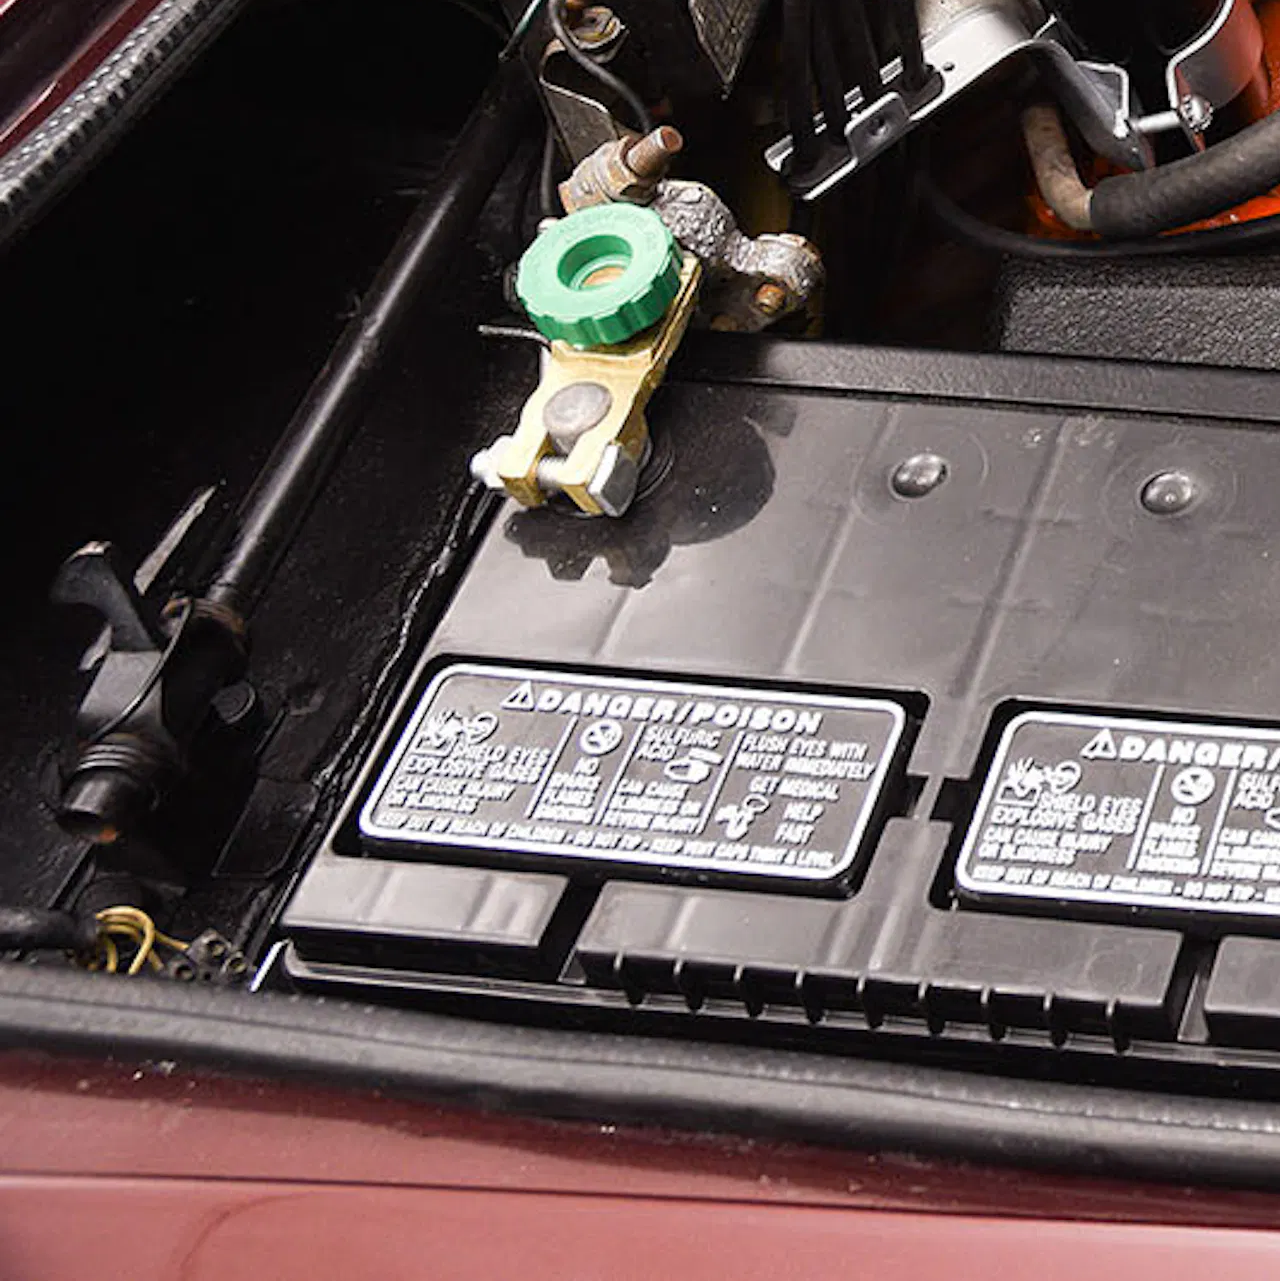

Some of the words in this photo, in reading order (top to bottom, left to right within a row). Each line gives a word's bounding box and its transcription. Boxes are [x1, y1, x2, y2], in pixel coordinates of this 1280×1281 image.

[534, 689, 824, 735] DANGER/POISON
[643, 725, 720, 748] SULFURIC
[742, 733, 788, 753] FLUSH
[788, 738, 827, 757] EYES
[828, 741, 867, 761] WITH
[506, 746, 550, 766] EYES
[635, 743, 676, 762] ACID
[734, 751, 783, 771] WATER
[748, 776, 778, 794] GET
[776, 778, 841, 801] MEDICAL
[1037, 791, 1096, 813] SHIELD
[1097, 796, 1142, 817] EYES
[1232, 790, 1274, 811] ACID
[782, 802, 823, 823] HELP
[989, 806, 1078, 830] EXPLOSIVE
[774, 823, 813, 844] FAST
